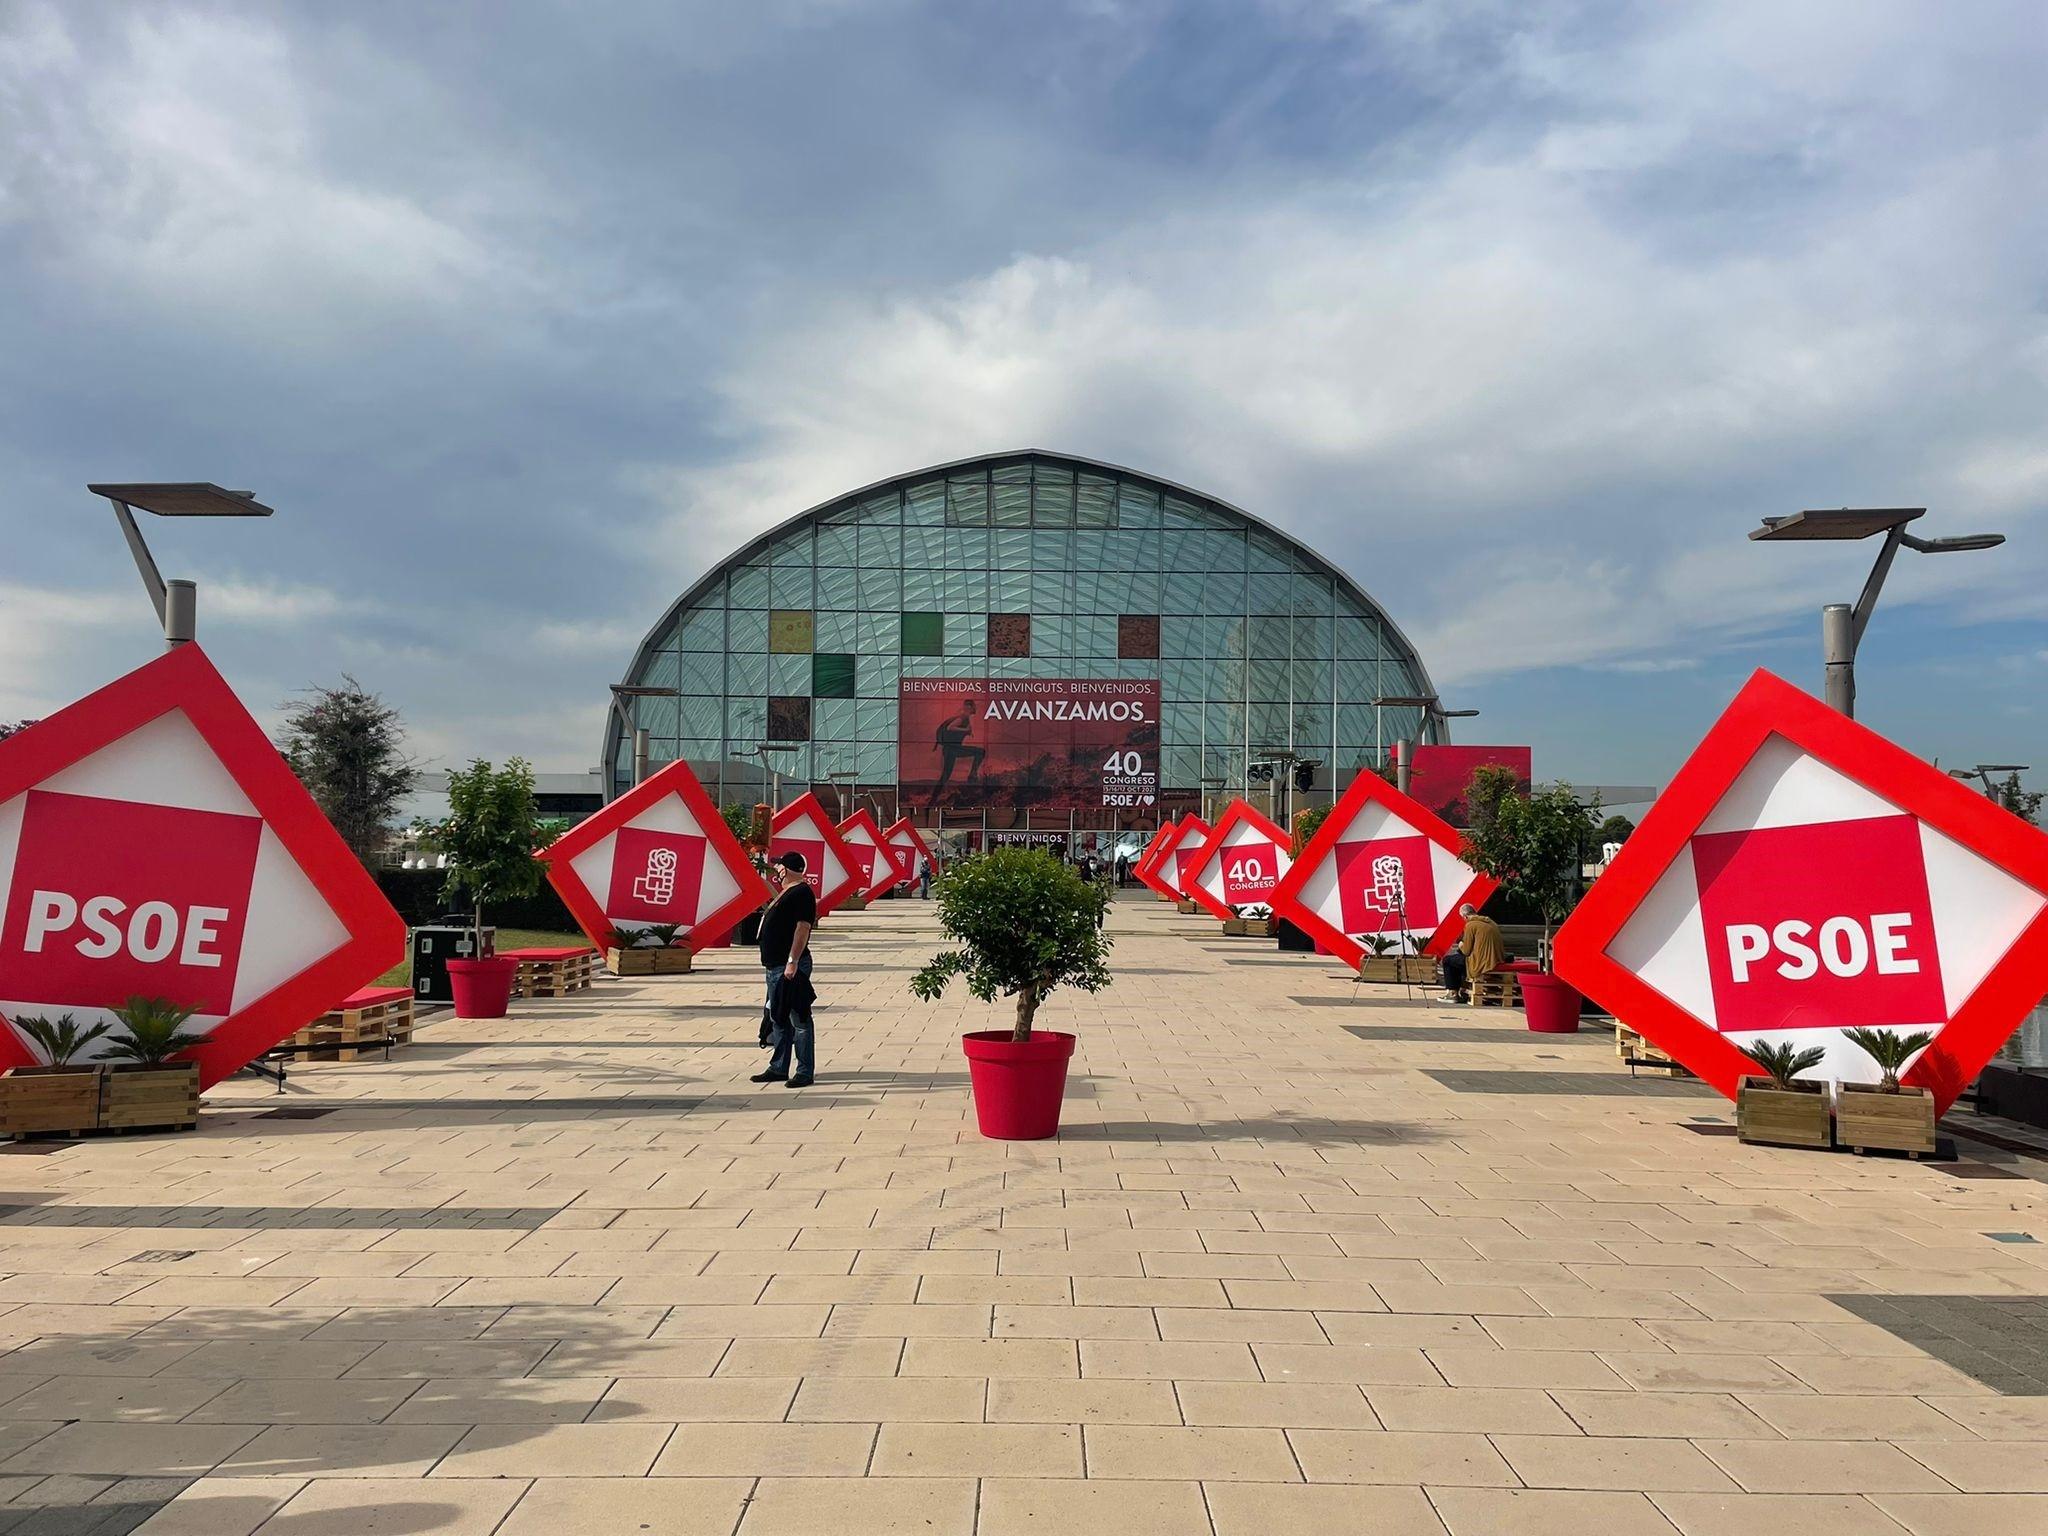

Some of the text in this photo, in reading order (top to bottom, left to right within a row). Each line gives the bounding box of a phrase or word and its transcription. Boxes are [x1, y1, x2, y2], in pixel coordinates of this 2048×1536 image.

[1103, 776, 1155, 784] CONGRESO
[1103, 795, 1133, 806] PSOE
[1230, 881, 1275, 890] CONGRESO
[23, 890, 229, 967] PSOE
[1725, 912, 1920, 983] PSOE
